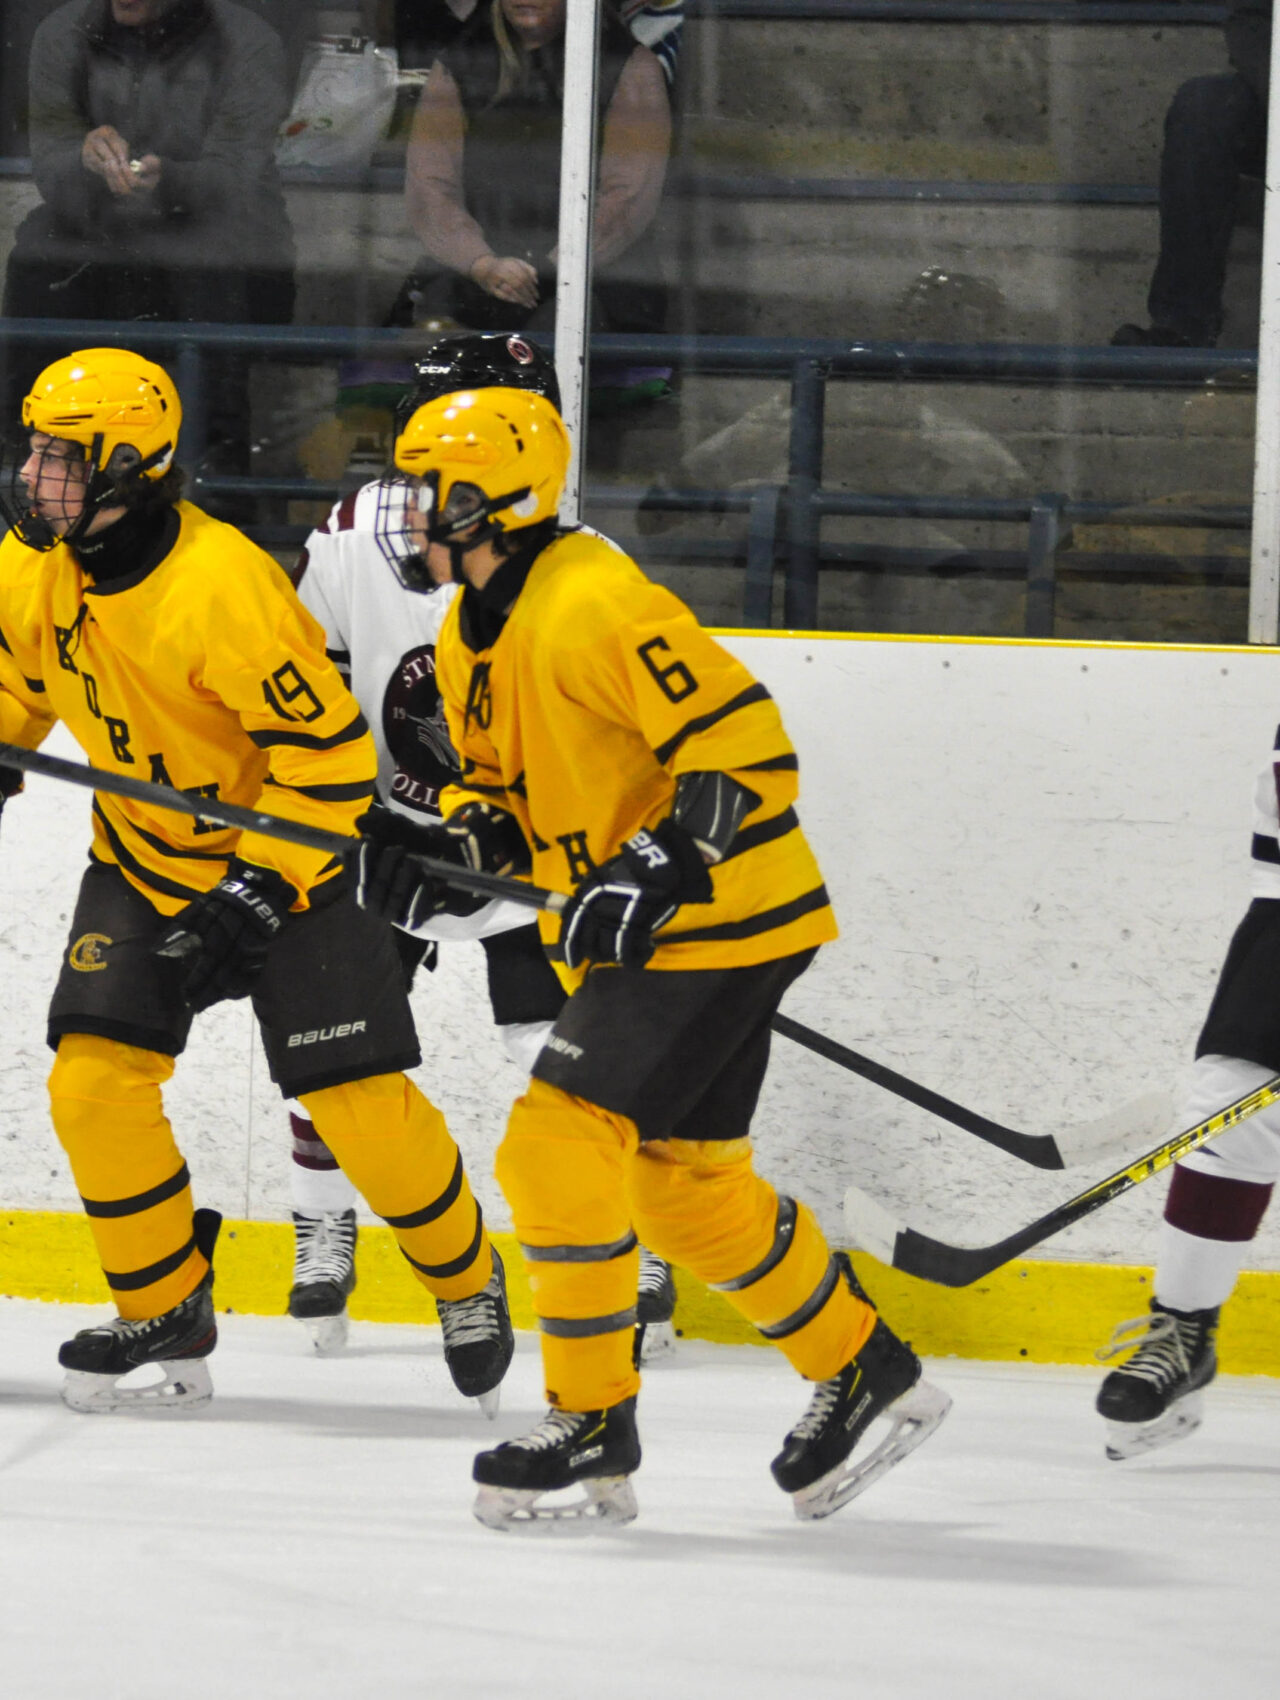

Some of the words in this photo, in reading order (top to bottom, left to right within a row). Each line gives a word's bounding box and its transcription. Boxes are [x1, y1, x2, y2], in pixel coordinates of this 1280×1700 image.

[419, 366, 451, 375] CCM
[261, 660, 326, 724] 19
[637, 635, 699, 704] 6
